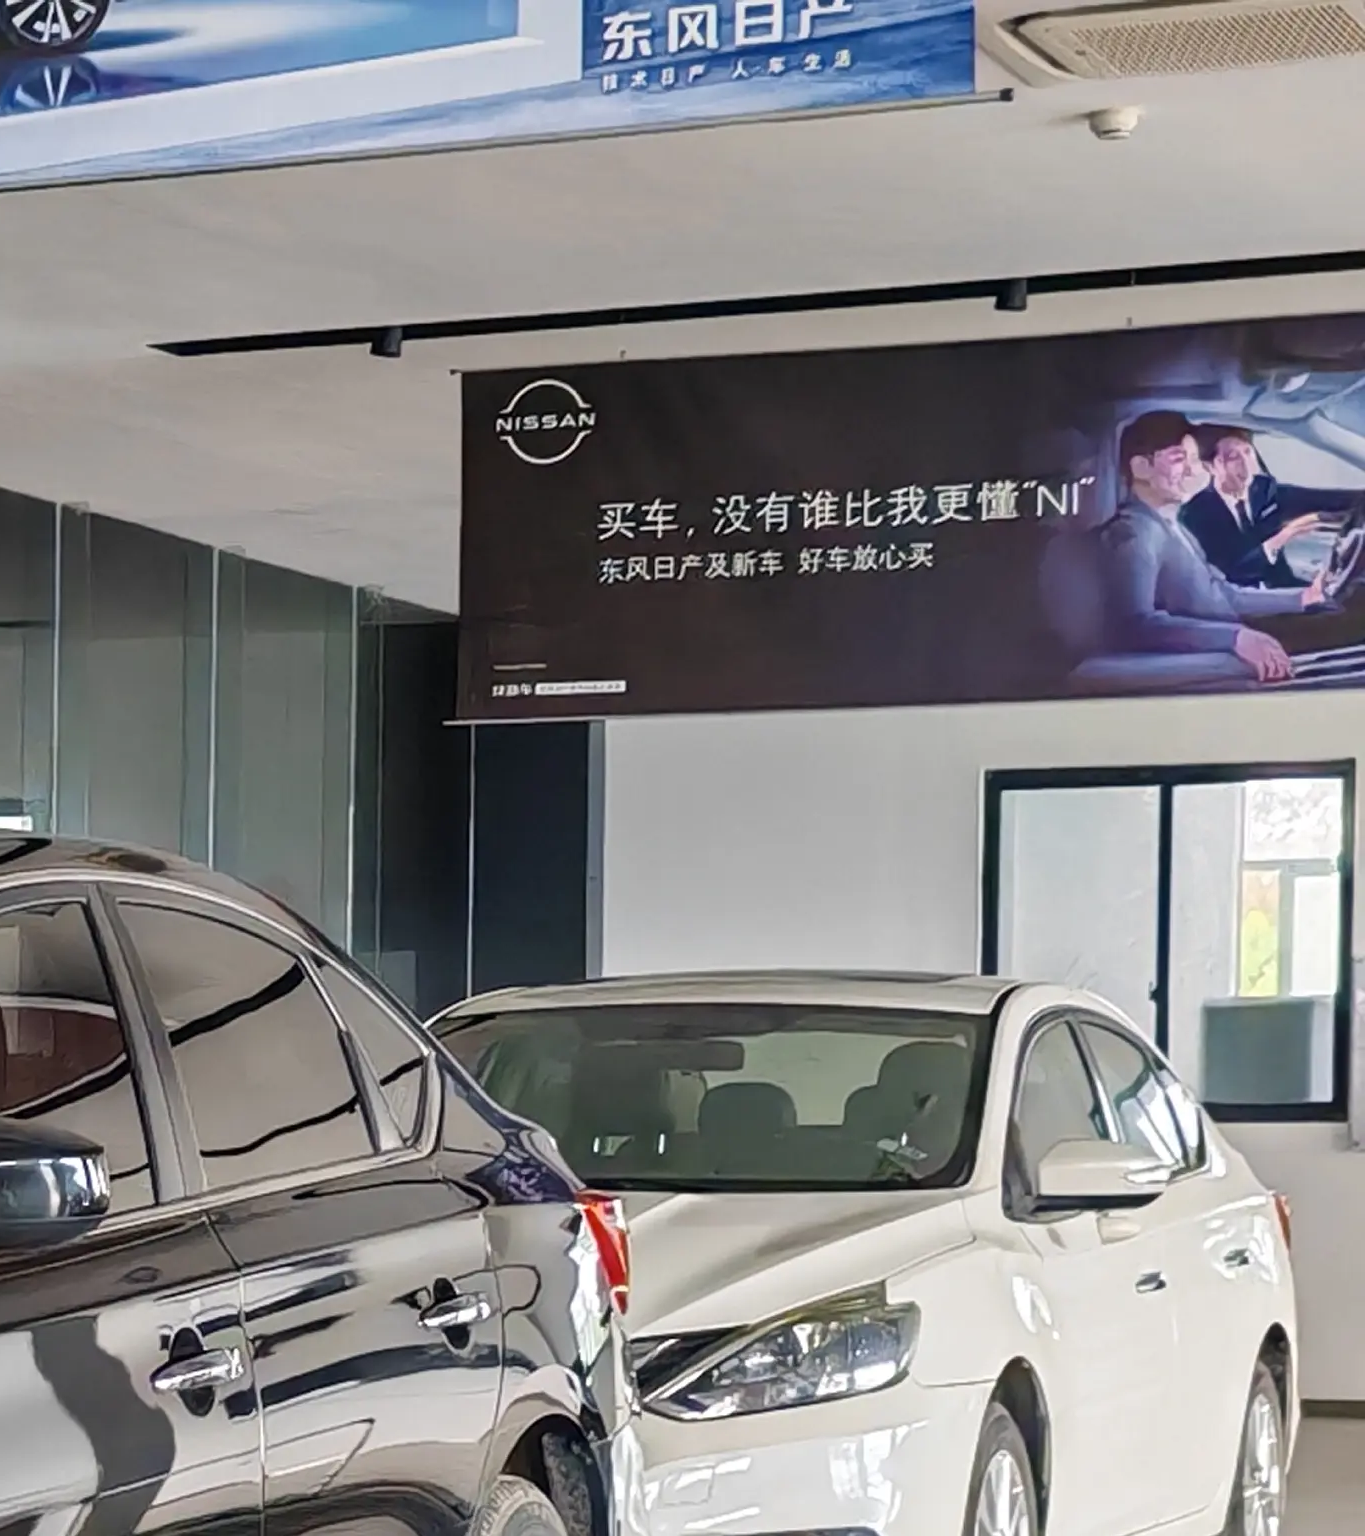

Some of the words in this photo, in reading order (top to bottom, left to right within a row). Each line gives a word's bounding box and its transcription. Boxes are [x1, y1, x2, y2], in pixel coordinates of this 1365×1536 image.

[602, 0, 853, 61] 东风日产
[495, 412, 597, 433] NISSAN
[797, 542, 934, 574] 好车放心买
